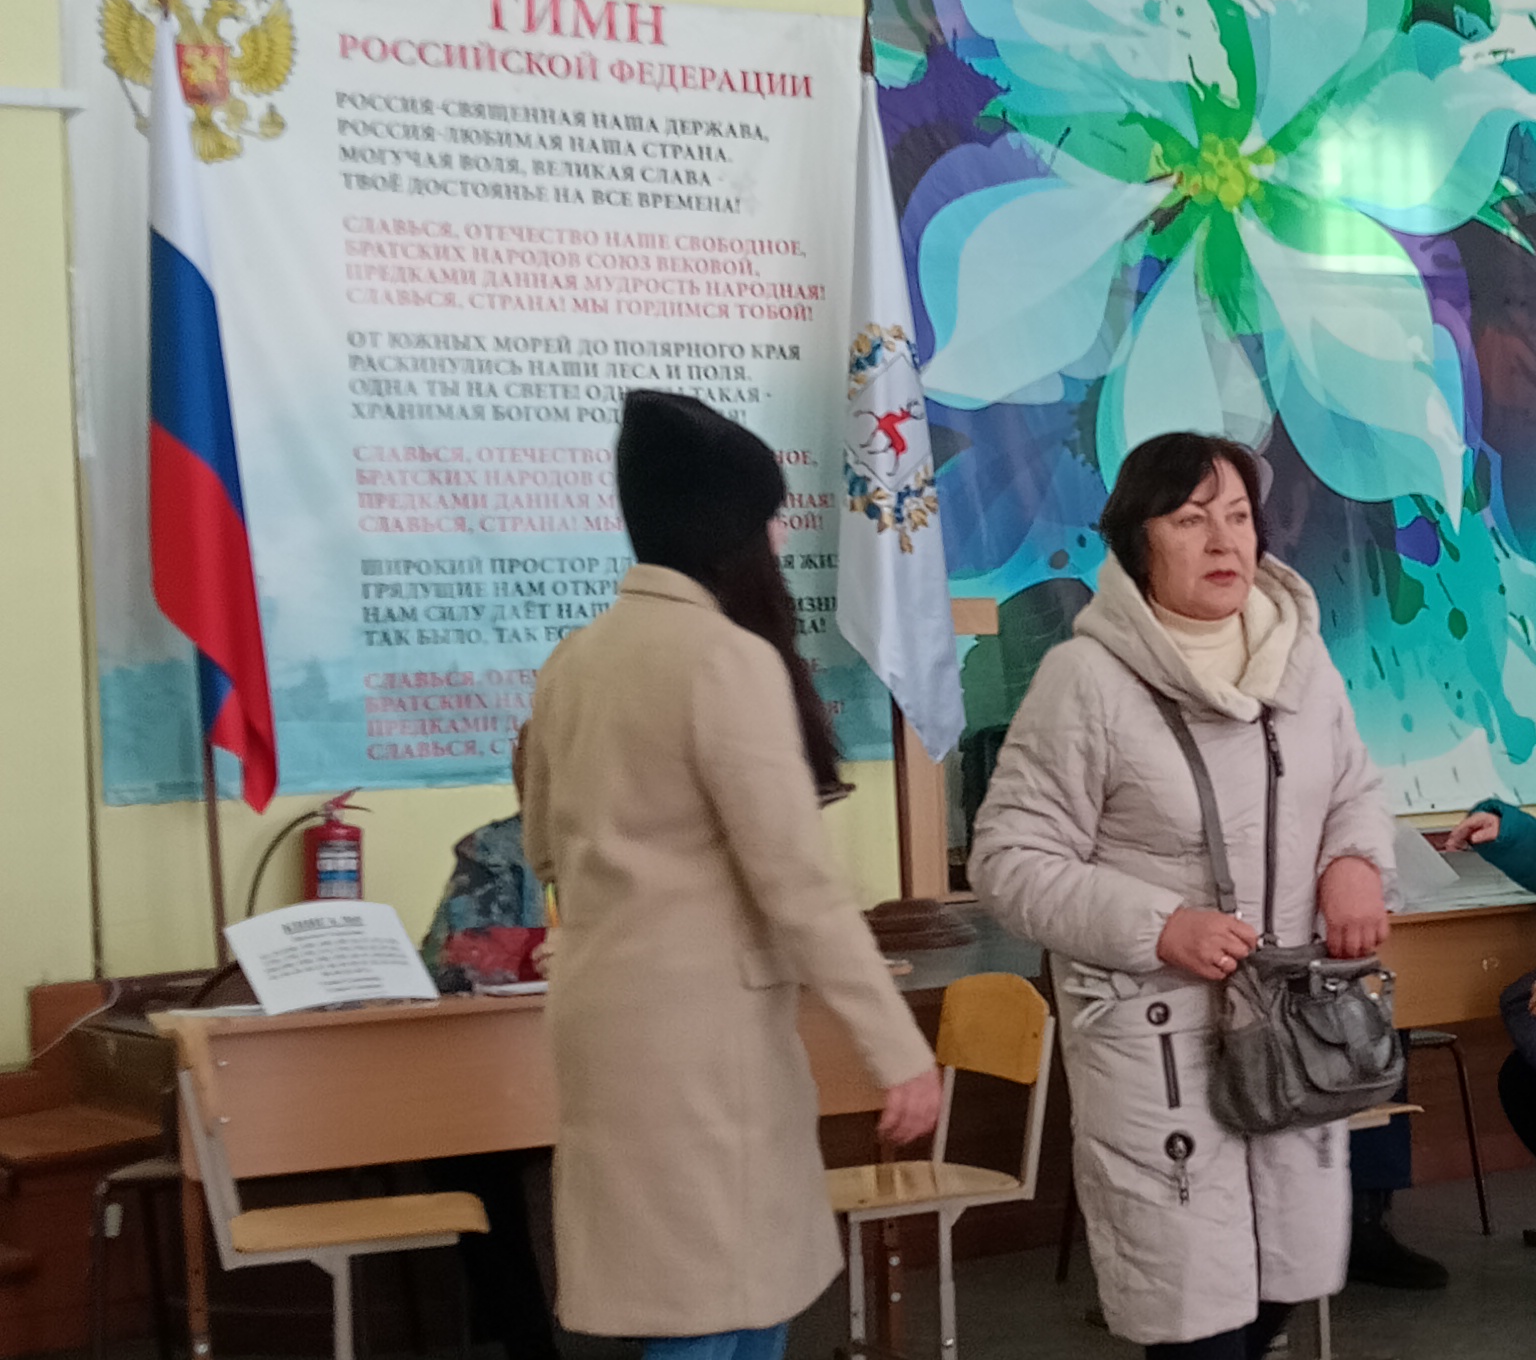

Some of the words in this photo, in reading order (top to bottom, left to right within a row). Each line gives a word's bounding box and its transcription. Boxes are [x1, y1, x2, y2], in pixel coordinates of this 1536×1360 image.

[339, 33, 600, 82] РОССИЙСКОЙ
[609, 60, 815, 100] ФЕДЕРАЦИИ
[592, 110, 659, 133] НАША
[665, 116, 770, 142] ДЕРЖАВА,
[569, 136, 637, 156] НАША
[339, 145, 453, 169] МОГУЧАЯ
[532, 159, 635, 181] ВЕЛИКАЯ
[641, 167, 712, 186] СЛАВА
[408, 177, 549, 202] ДОСТОЯНЬЕ
[553, 186, 585, 204] НА
[591, 189, 632, 207] ВСЕ
[638, 191, 741, 214] ВРЕМЕНА!
[464, 223, 599, 246] ОТЕЧЕСТВО
[604, 231, 670, 249] НАШЕ
[675, 234, 807, 258] СВОБОДНОЕ,
[344, 239, 466, 263] БРАТСКИХ
[472, 246, 581, 268] НАРОДОВ
[586, 253, 651, 272] СОЮЗ
[345, 263, 476, 285] ПРЕДКАМИ
[482, 270, 577, 290] ДАННАЯ
[583, 275, 700, 296] МУДРОСТЬ
[705, 280, 826, 301] НАРОДНАЯ!
[468, 292, 567, 312] СТРАНА!
[572, 297, 609, 314] МЫ
[615, 299, 730, 319] ГОРДИМСЯ
[734, 303, 813, 322] ТОБОЙ!
[346, 331, 384, 349] ОТ
[387, 332, 487, 352] ЮЖНЫХ
[492, 333, 572, 354] МОРЕЙ
[577, 339, 608, 357] ДО
[614, 340, 745, 360] ПОЛЯРНОГО
[751, 344, 801, 361] КРАЯ
[348, 354, 522, 376] РАСКИНУЛИСЬ
[528, 360, 598, 377] НАШИ
[606, 363, 660, 380] ЛЕСА
[666, 364, 681, 380] И
[349, 379, 417, 397] ОДНА
[426, 379, 460, 397] ТЫ
[466, 380, 499, 398] НА
[504, 382, 580, 400] СВЕТЕ!
[586, 384, 632, 403] ОДН
[351, 402, 486, 421] ХРАНИМАЯ
[492, 405, 571, 422] БОГОМ
[476, 447, 612, 463] ОТЕЧЕСТВО
[355, 468, 477, 486] БРАТСКИХ
[484, 470, 593, 487] НАРОДОВ
[357, 492, 488, 510] ПРЕДКАМИ
[495, 493, 590, 511] ДАННАЯ
[479, 515, 577, 533] СТРАНА!
[585, 516, 625, 532] МЫ
[361, 555, 483, 576] ШИРОКИЙ
[490, 557, 600, 574] ПРОСТОР
[361, 581, 489, 600] ГРЯДУЩИЕ
[492, 580, 546, 597] НАМ
[362, 605, 418, 623] НАМ
[423, 604, 485, 622] СИЛУ
[493, 600, 551, 620] ДАЁТ
[364, 629, 411, 646] ТАК
[492, 626, 537, 644] ТАК
[365, 693, 487, 714] БРАТСКИХ
[367, 716, 497, 737] ПРЕДКАМИ
